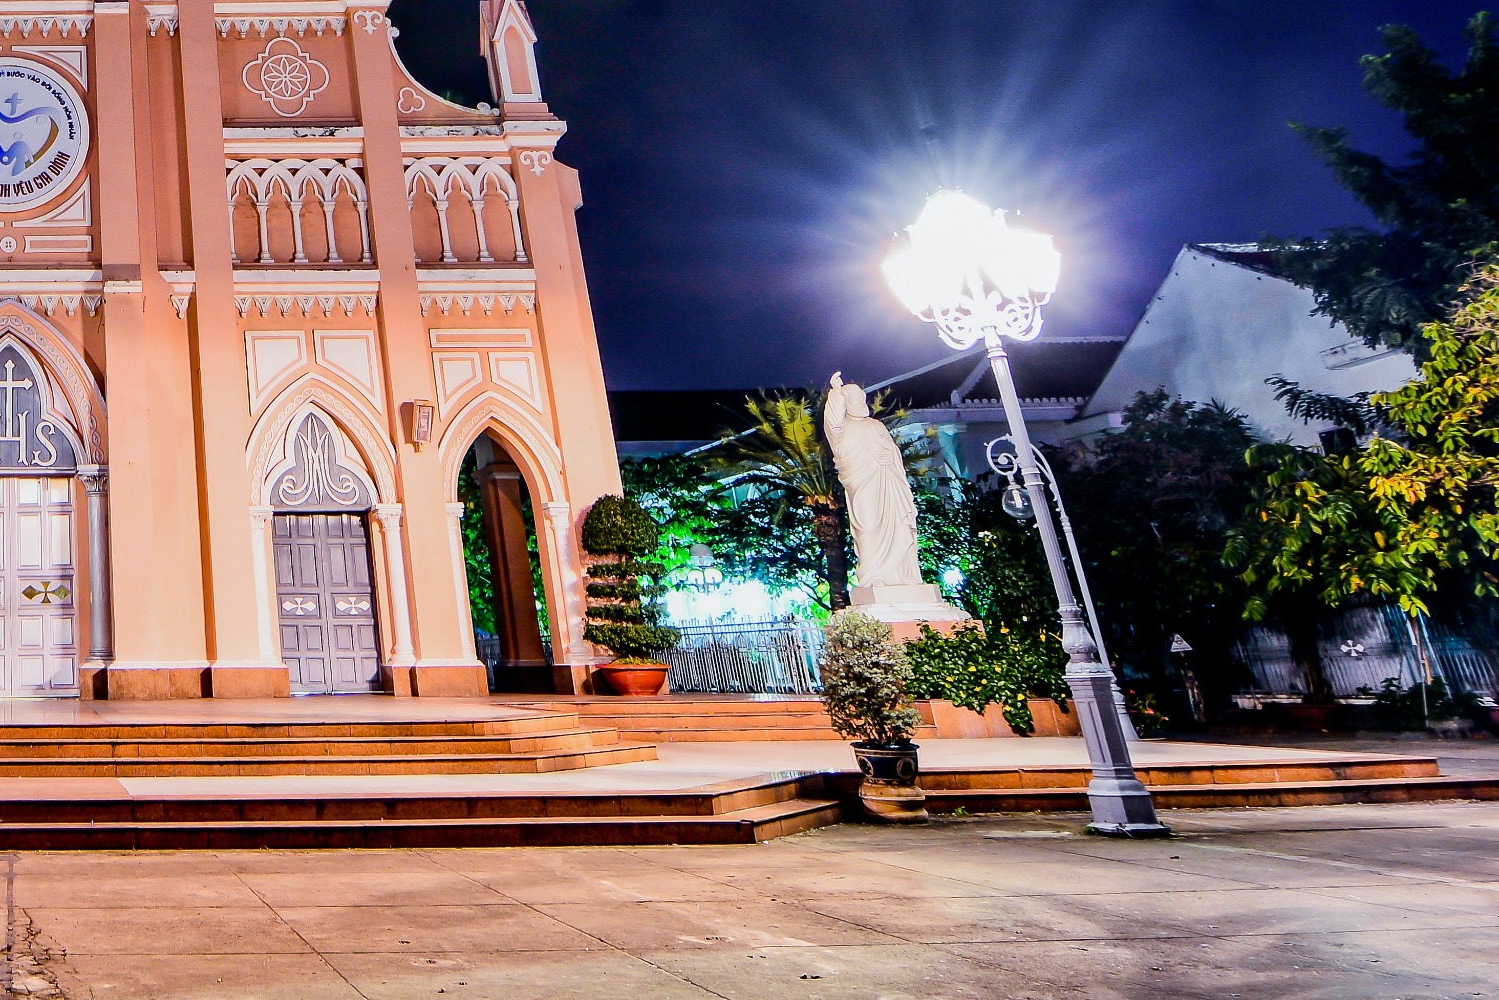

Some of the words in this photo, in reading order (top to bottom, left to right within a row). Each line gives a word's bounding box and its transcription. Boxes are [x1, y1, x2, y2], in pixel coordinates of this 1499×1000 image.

[27, 74, 40, 84] VÀO
[62, 106, 72, 120] HÔN
[12, 180, 34, 197] YÊU
[33, 171, 54, 190] GIA
[48, 151, 71, 176] ĐÌNH
